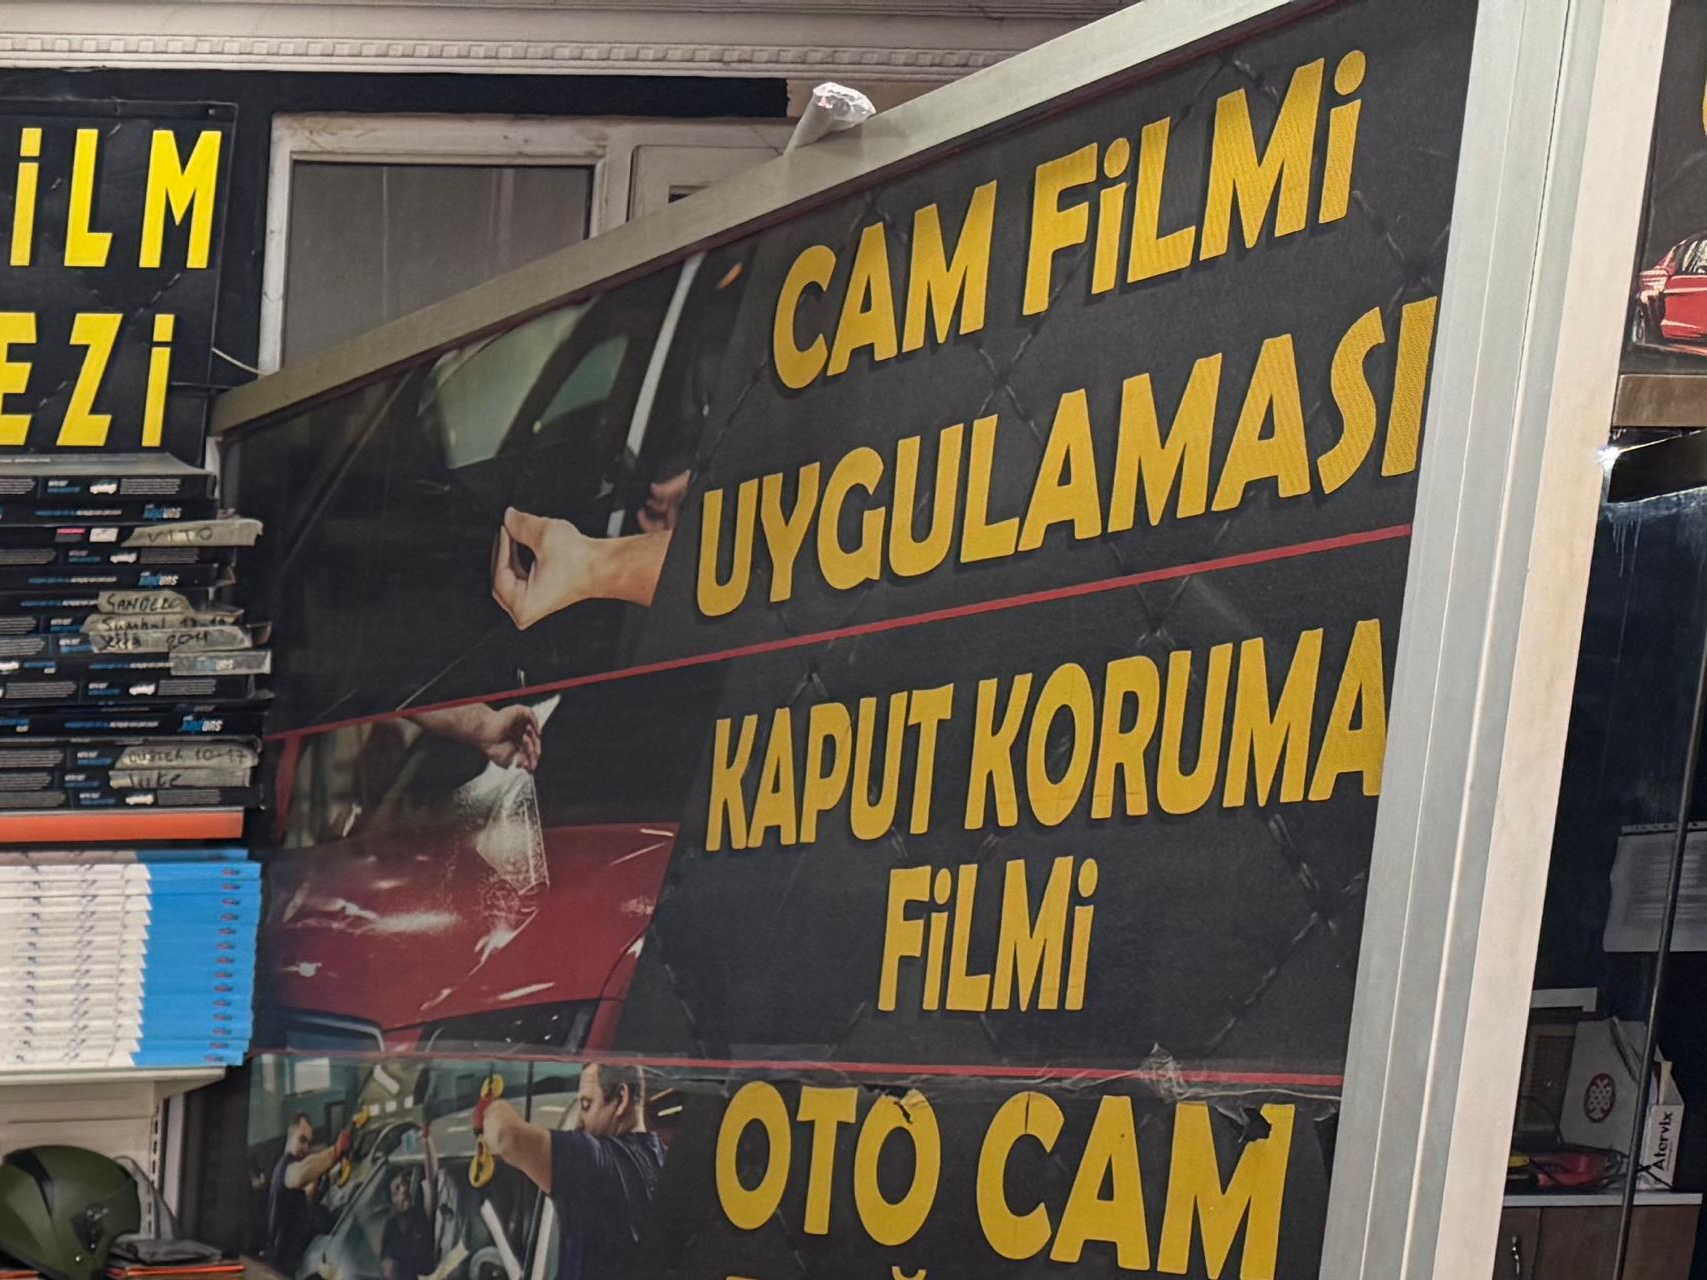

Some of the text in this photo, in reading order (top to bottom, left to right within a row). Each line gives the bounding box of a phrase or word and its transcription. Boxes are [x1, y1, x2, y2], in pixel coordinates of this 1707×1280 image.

[772, 49, 1367, 389] CAM FİLMİ
[696, 296, 1438, 616] UYGULAMASI
[705, 617, 1386, 851] KAPUT KORUMA
[878, 855, 1098, 1011] FİLMİ
[715, 1081, 941, 1246] OTO
